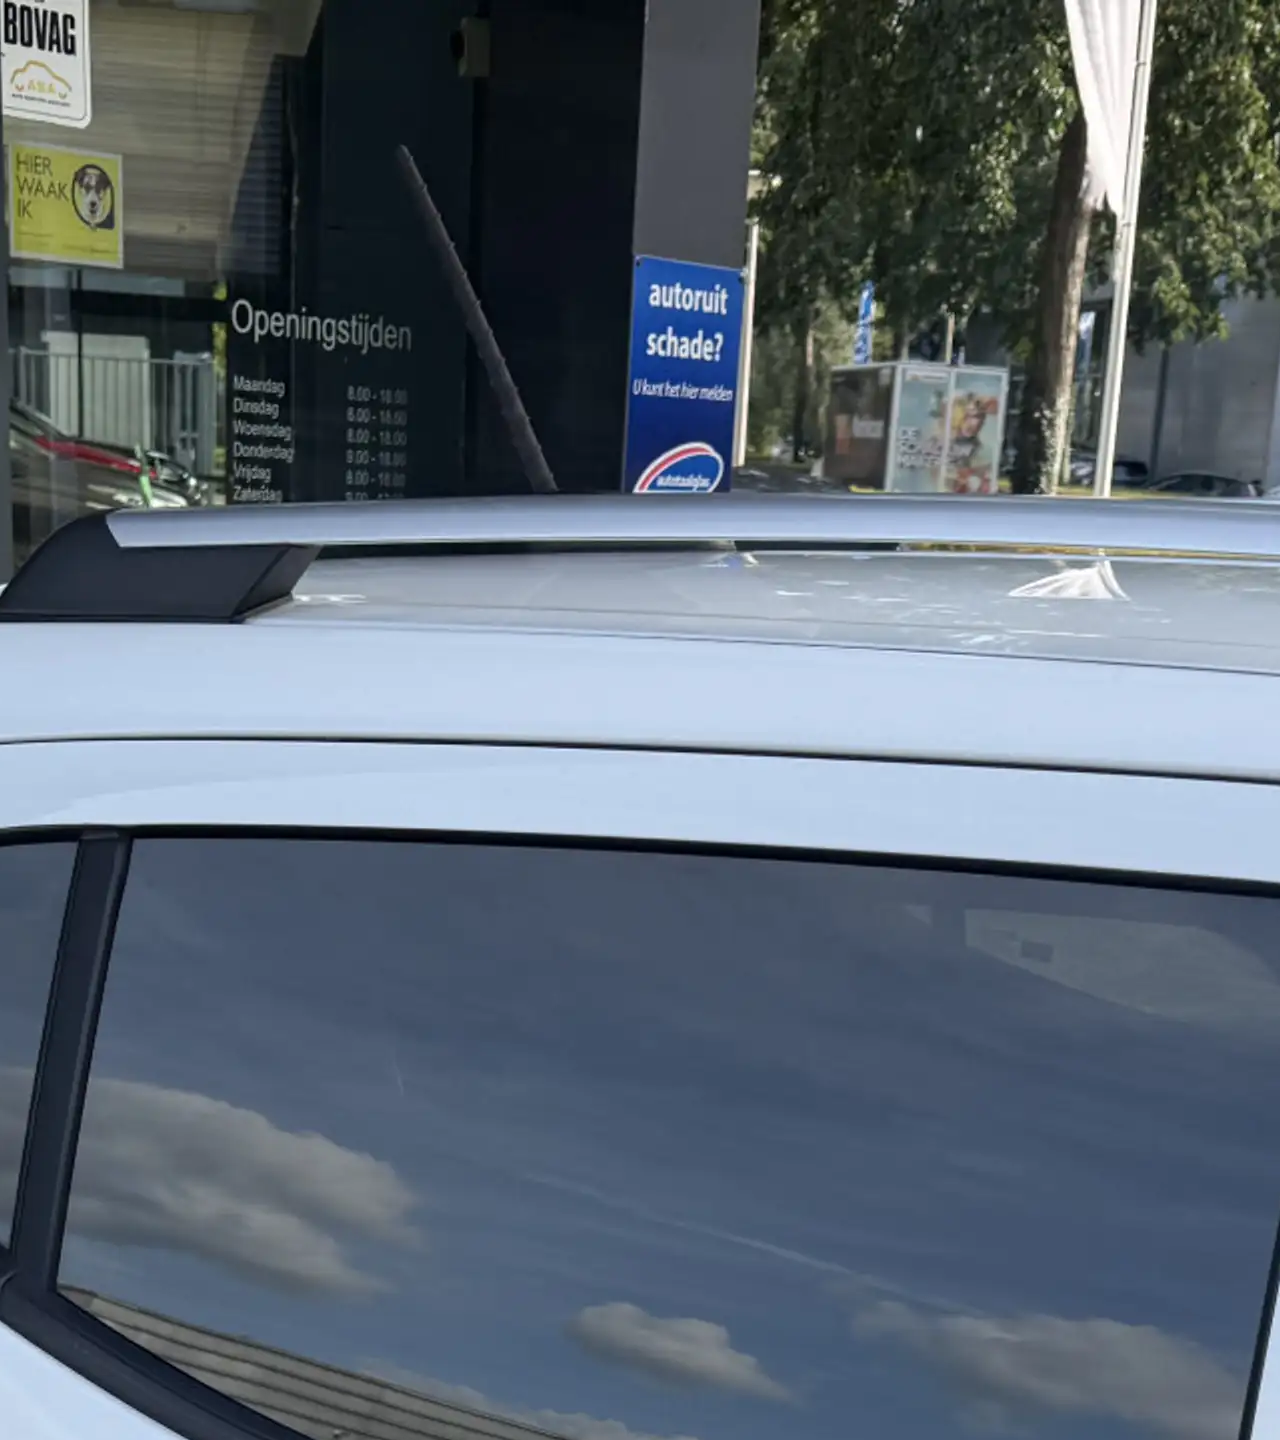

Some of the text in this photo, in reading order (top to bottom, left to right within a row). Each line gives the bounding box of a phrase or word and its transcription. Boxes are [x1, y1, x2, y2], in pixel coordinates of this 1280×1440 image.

[4, 1, 76, 56] BOVAG
[16, 152, 53, 177] HIER
[16, 175, 70, 202] WAAK
[17, 198, 33, 219] IK
[648, 281, 729, 316] autoruit
[231, 298, 413, 355] Openingstijden
[646, 324, 724, 362] schade?
[233, 374, 286, 398] Maandag
[632, 378, 734, 403] U kunt het hier melden
[233, 398, 280, 419] Dinsdag
[232, 419, 292, 442] Woensdag
[233, 441, 295, 463] Donderdag
[233, 460, 272, 484] Vrijdag
